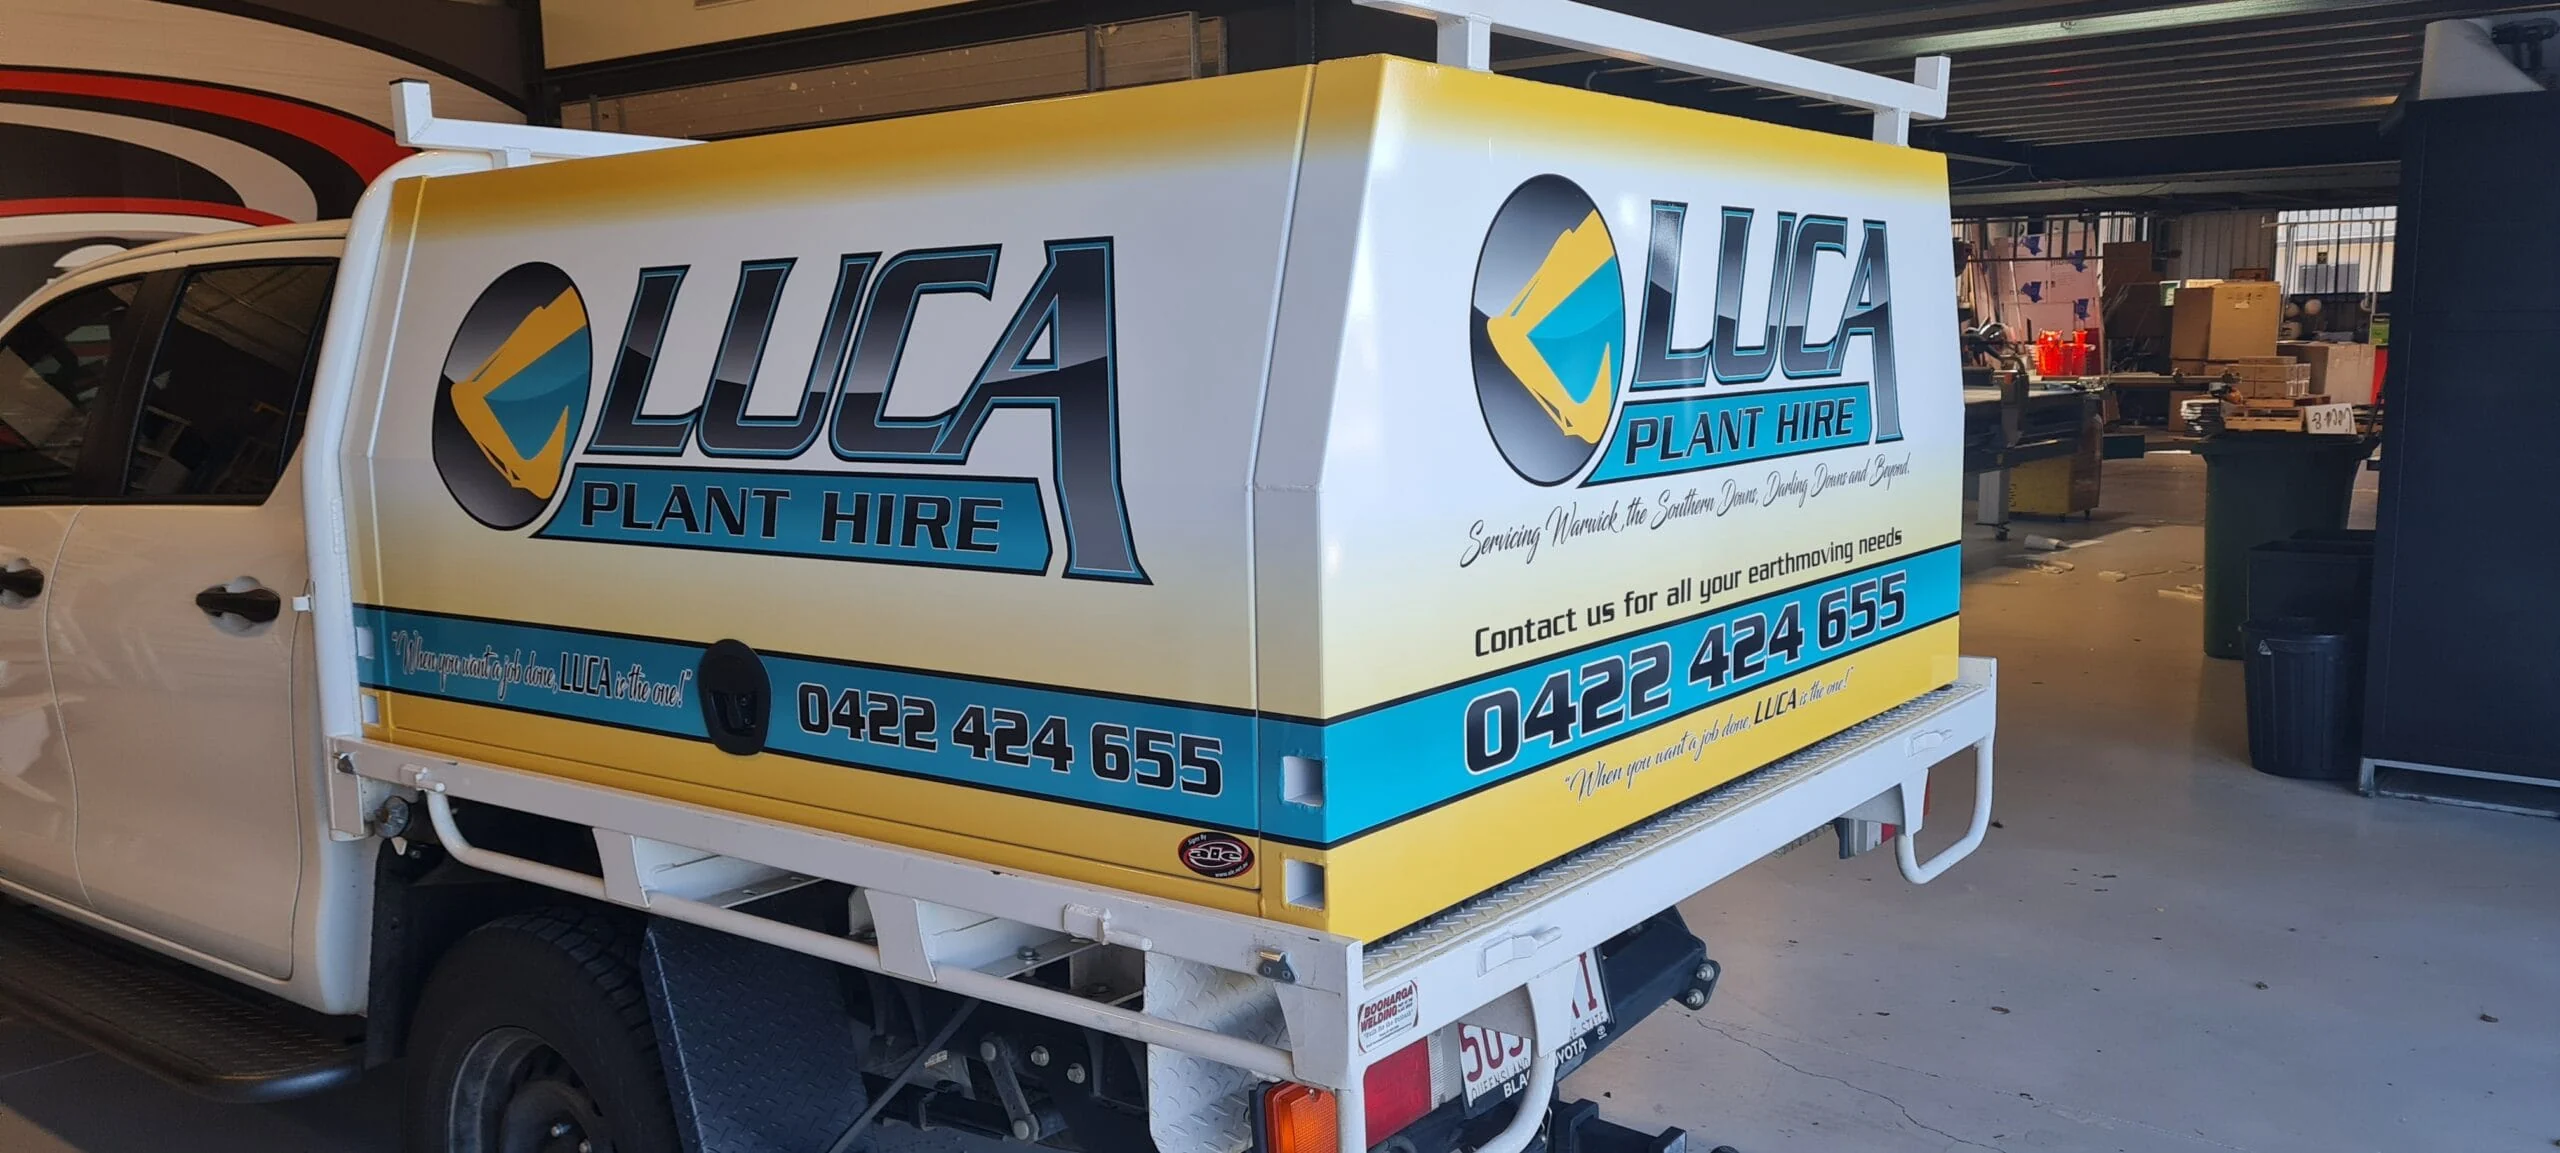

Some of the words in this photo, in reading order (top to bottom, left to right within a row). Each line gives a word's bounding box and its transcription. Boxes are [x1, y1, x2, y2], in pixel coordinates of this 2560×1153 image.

[1629, 199, 1904, 444] LUCA
[584, 236, 1154, 585] LUCA
[1625, 406, 1764, 466] PLANT
[1776, 397, 1857, 444] HIRE
[581, 481, 790, 538] PLANT
[820, 490, 1004, 553] HIRE
[1460, 519, 1541, 568] Servicing
[1625, 496, 1648, 527] the
[1650, 489, 1714, 530] Southern
[1716, 478, 1758, 518] Downs,
[1763, 470, 1808, 508] Darling
[1810, 462, 1847, 498] Downs
[1847, 458, 1870, 485] and
[1869, 451, 1911, 491] Beyond.
[1475, 608, 1578, 657] Contact
[1587, 602, 1615, 627] us
[1624, 590, 1658, 617] for
[1667, 577, 1692, 607] all
[1700, 570, 1742, 604] your
[1749, 541, 1853, 584] earthmoving
[1859, 527, 1903, 555] needs
[391, 630, 436, 675] "When
[435, 652, 460, 692] you
[462, 645, 498, 680] want
[491, 659, 502, 680] a
[498, 648, 522, 701] job
[523, 650, 558, 694] done,
[559, 652, 613, 698] LUCA
[614, 671, 628, 699] is
[628, 663, 650, 702] the
[651, 669, 693, 708] one!"
[1463, 640, 1673, 776] 0422
[1687, 600, 1804, 691] 424
[1816, 569, 1908, 651] 655
[797, 682, 938, 752] 0422
[951, 703, 1074, 774] 424
[1090, 721, 1223, 797] 655
[1564, 761, 1622, 801] "When
[1626, 755, 1652, 789] you
[1655, 731, 1692, 765] want
[1688, 737, 1697, 751] a
[1694, 720, 1719, 762] job
[1721, 713, 1752, 737] done,
[1754, 687, 1797, 725] LUCA
[1800, 691, 1808, 706] is
[1810, 680, 1824, 701] the
[1361, 1004, 1397, 1033] WELDING
[1364, 984, 1413, 1019] BOONARGA
[1581, 1011, 1606, 1032] STATE
[1471, 1057, 1529, 1100] QUEENSLAND
[1503, 1069, 1531, 1098] BLA
